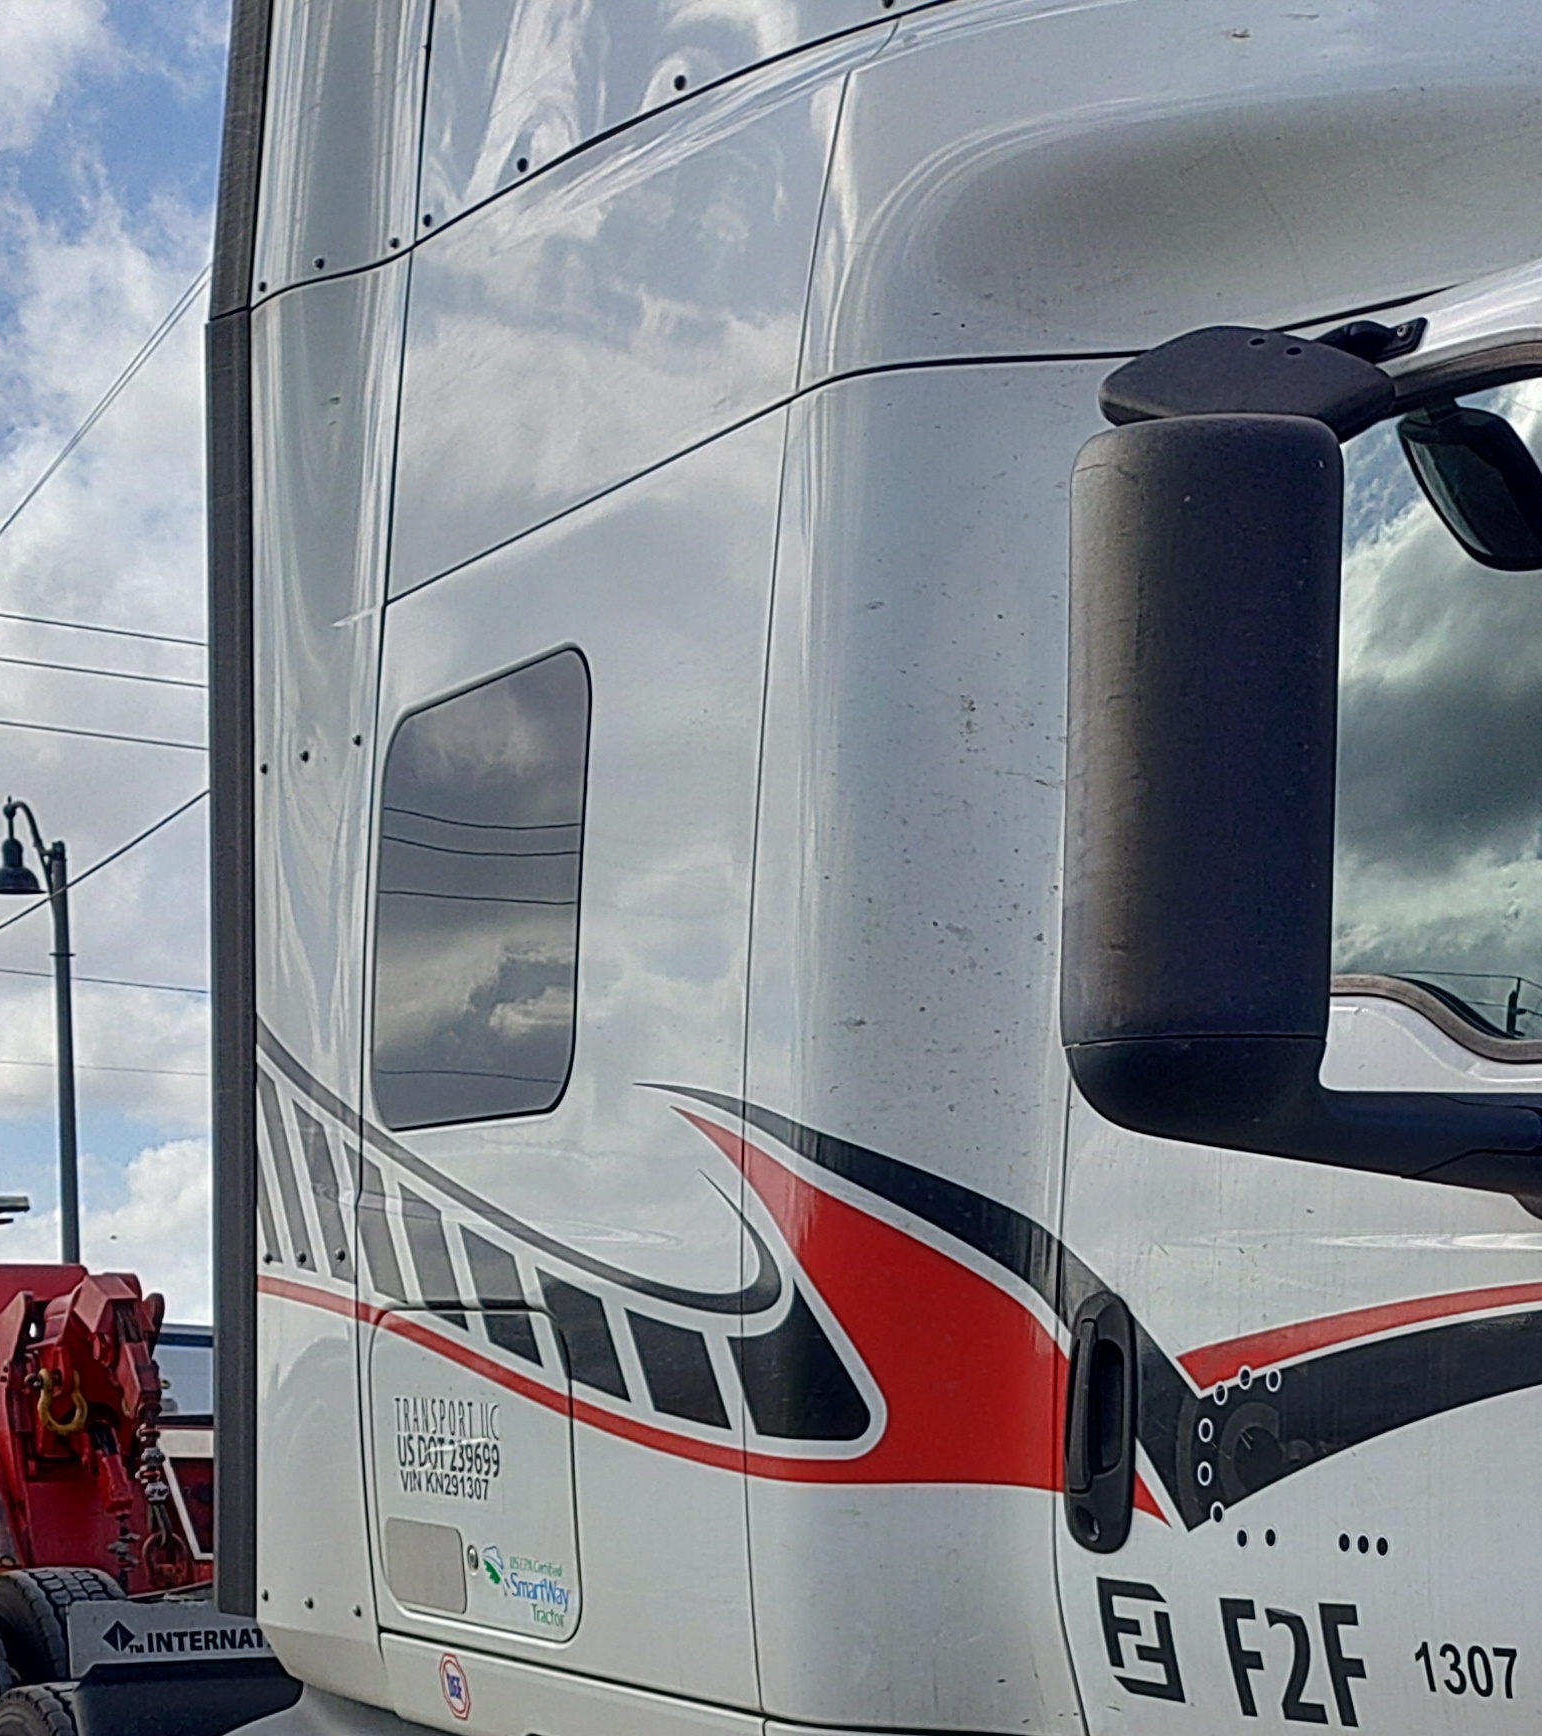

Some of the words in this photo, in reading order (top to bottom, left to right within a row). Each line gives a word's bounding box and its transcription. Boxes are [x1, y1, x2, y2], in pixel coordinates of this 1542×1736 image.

[395, 1397, 473, 1438] TRANSPORT
[480, 1402, 499, 1440] LLC
[398, 1434, 415, 1467] US
[418, 1435, 445, 1470] DOT
[449, 1439, 500, 1478] 239699
[400, 1470, 421, 1492] VIN
[425, 1471, 489, 1501] KN291307
[510, 1572, 571, 1613] SmartWay
[531, 1603, 565, 1627] Tractor
[147, 1628, 272, 1653] INTERNAT
[1219, 1597, 1367, 1728] F2F
[1414, 1641, 1518, 1699] 1307
